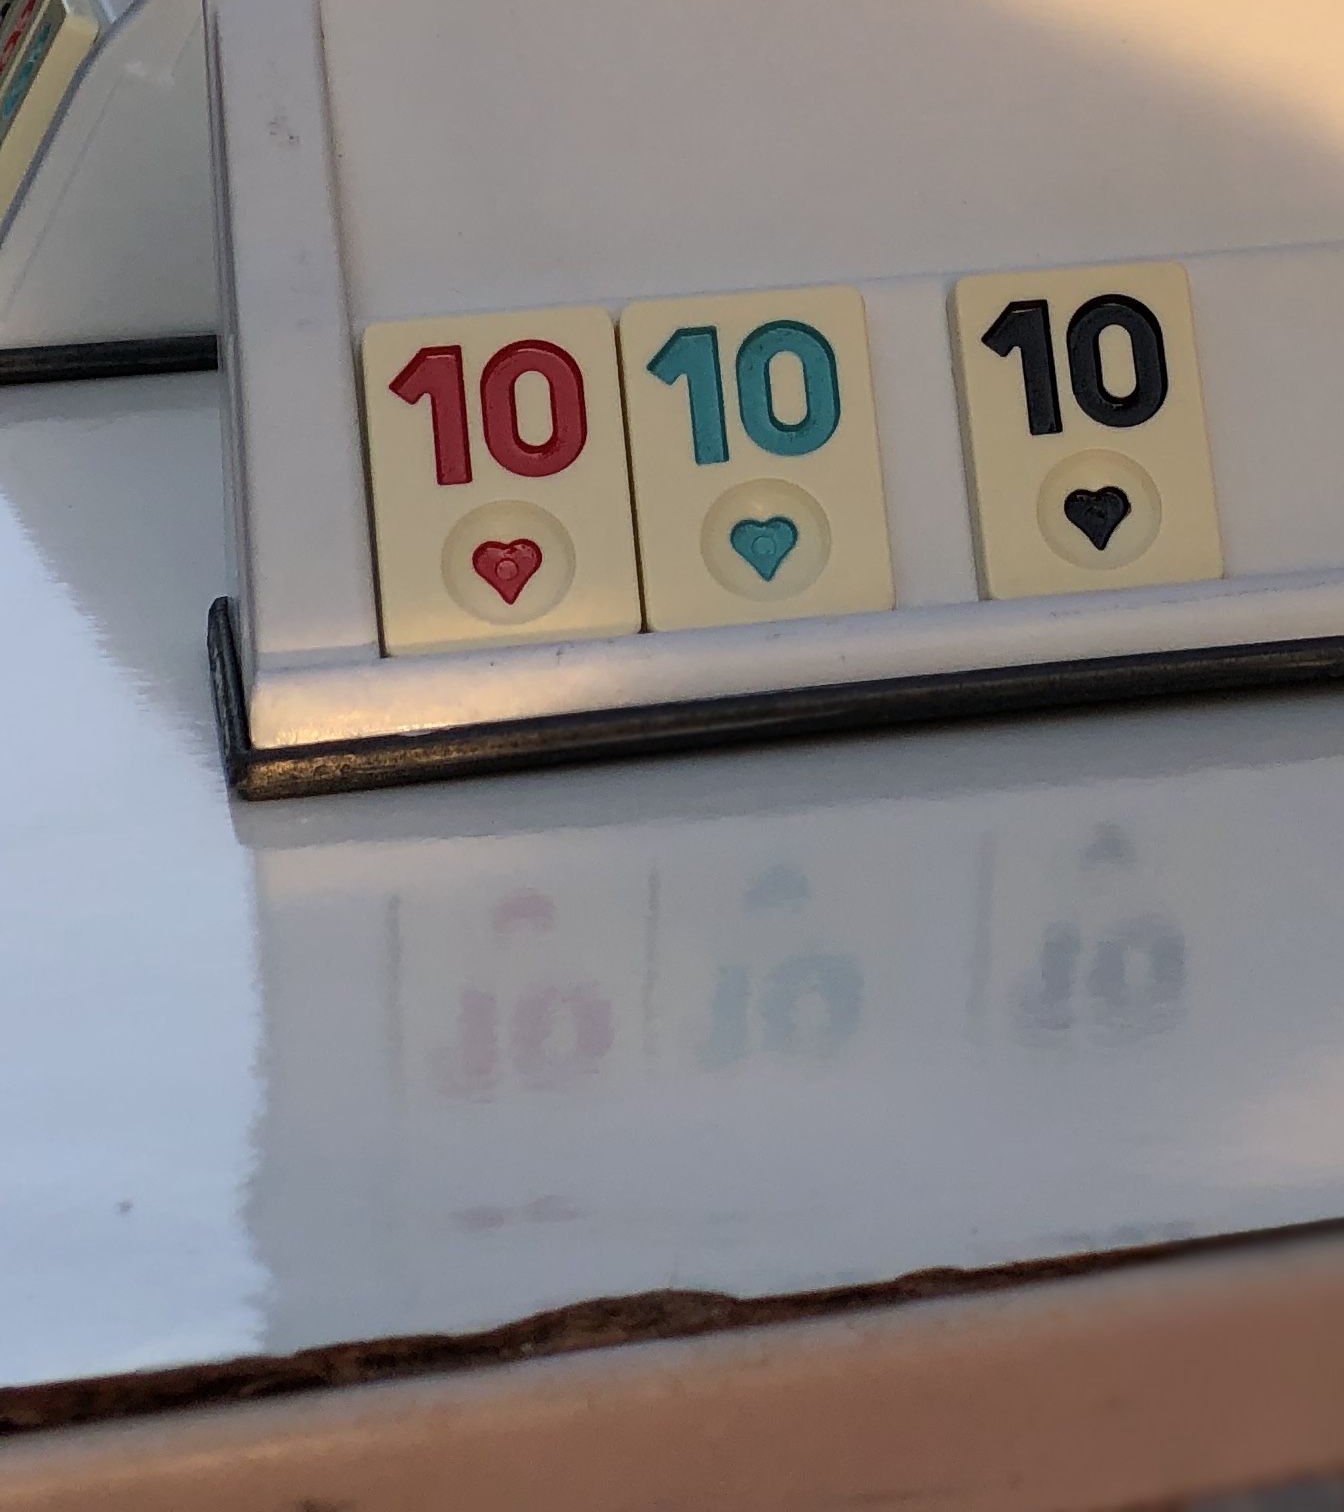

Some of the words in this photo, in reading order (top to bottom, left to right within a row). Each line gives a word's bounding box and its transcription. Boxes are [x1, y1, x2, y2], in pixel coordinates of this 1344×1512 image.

[388, 338, 588, 486] 10
[646, 319, 841, 466] 10
[981, 293, 1168, 436] 10
